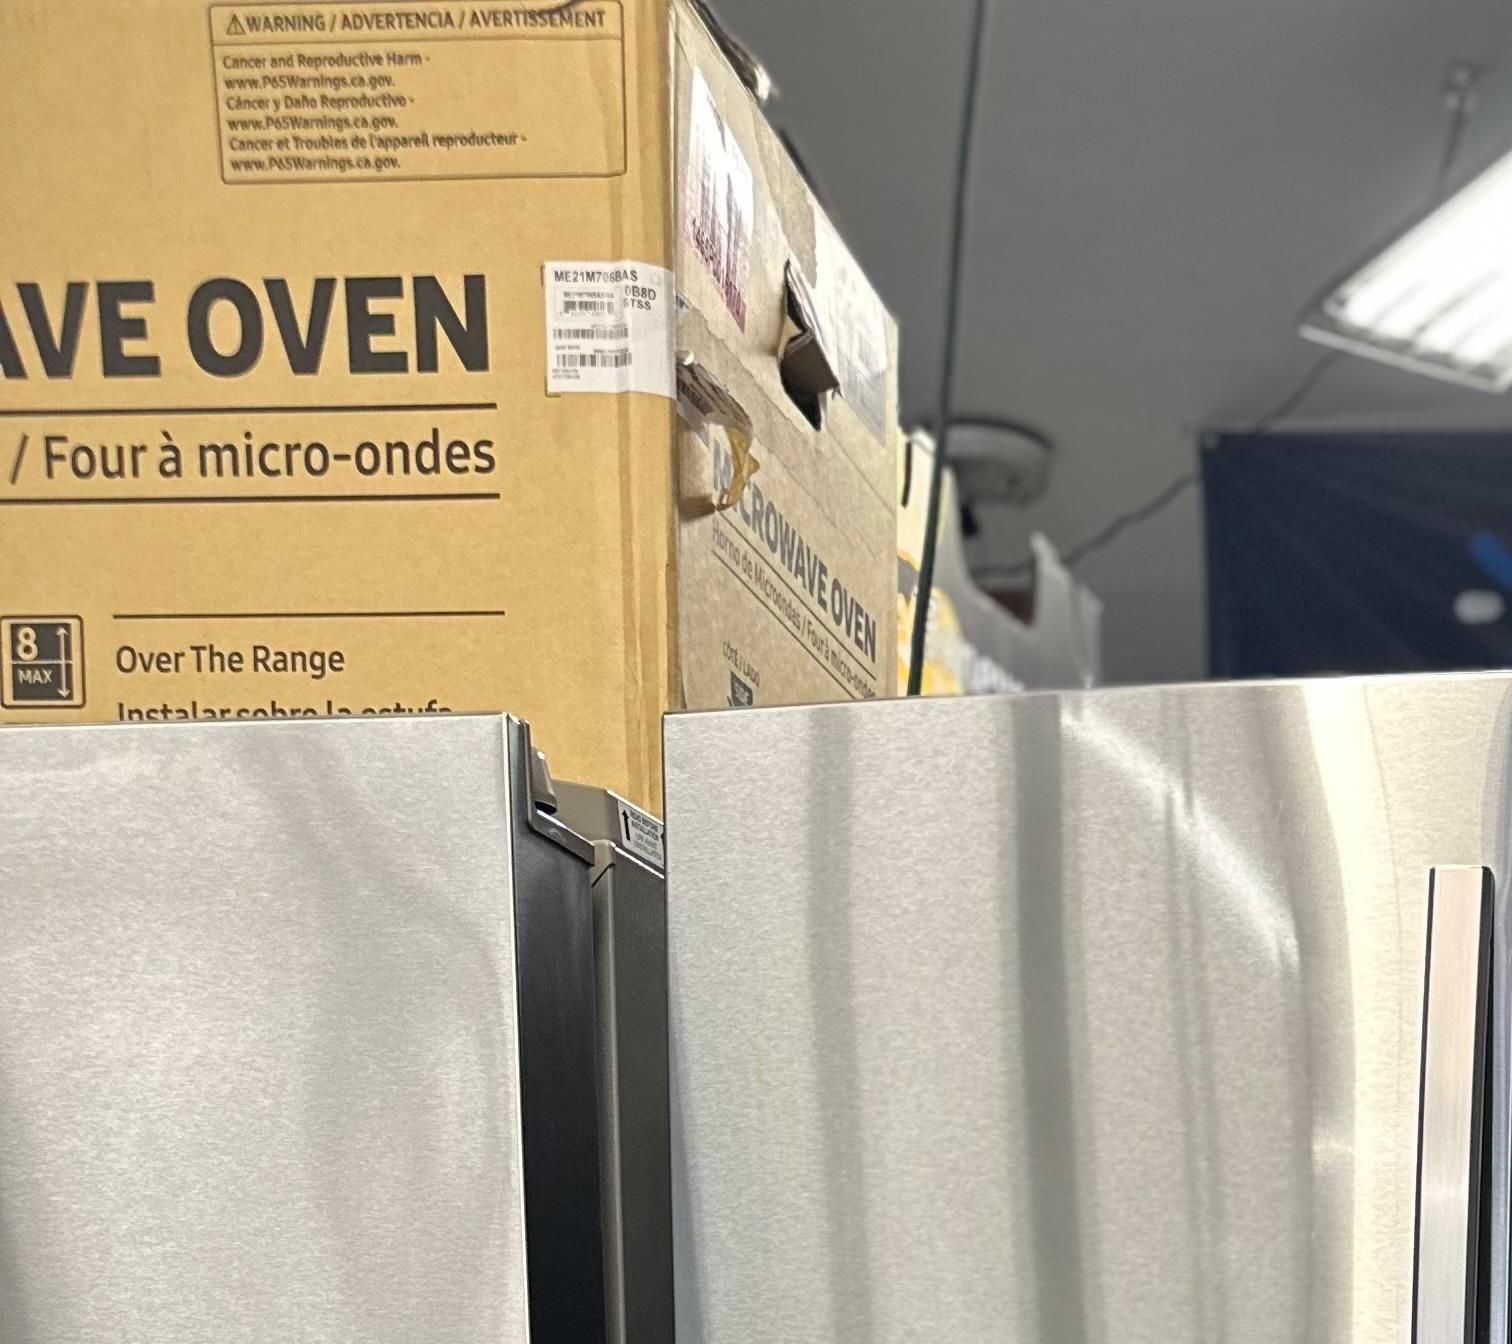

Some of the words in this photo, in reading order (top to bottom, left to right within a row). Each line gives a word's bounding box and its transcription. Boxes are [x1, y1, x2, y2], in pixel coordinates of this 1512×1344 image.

[245, 14, 326, 33] WARNING
[341, 11, 455, 31] ADVERTENCIA
[469, 9, 607, 29] AVERTISSEMENT
[223, 55, 267, 70] Cancer
[270, 53, 294, 69] and
[298, 52, 384, 72] Reproductive
[387, 50, 423, 66] Harm
[273, 98, 281, 113] y
[284, 94, 318, 110] Daño
[229, 137, 273, 152] Cancer
[276, 137, 291, 151] et
[292, 134, 349, 151] Troubles
[351, 133, 367, 149] de
[433, 128, 518, 151] reproducteur
[187, 273, 490, 379] OVEN
[44, 434, 147, 480] Four
[158, 430, 184, 479] à
[199, 427, 497, 479] micro-ondes
[831, 577, 877, 665] OVEN
[16, 627, 39, 661] 8
[18, 668, 53, 686] MAX
[115, 645, 185, 674] Over
[190, 645, 244, 673] The
[252, 645, 346, 680] Range
